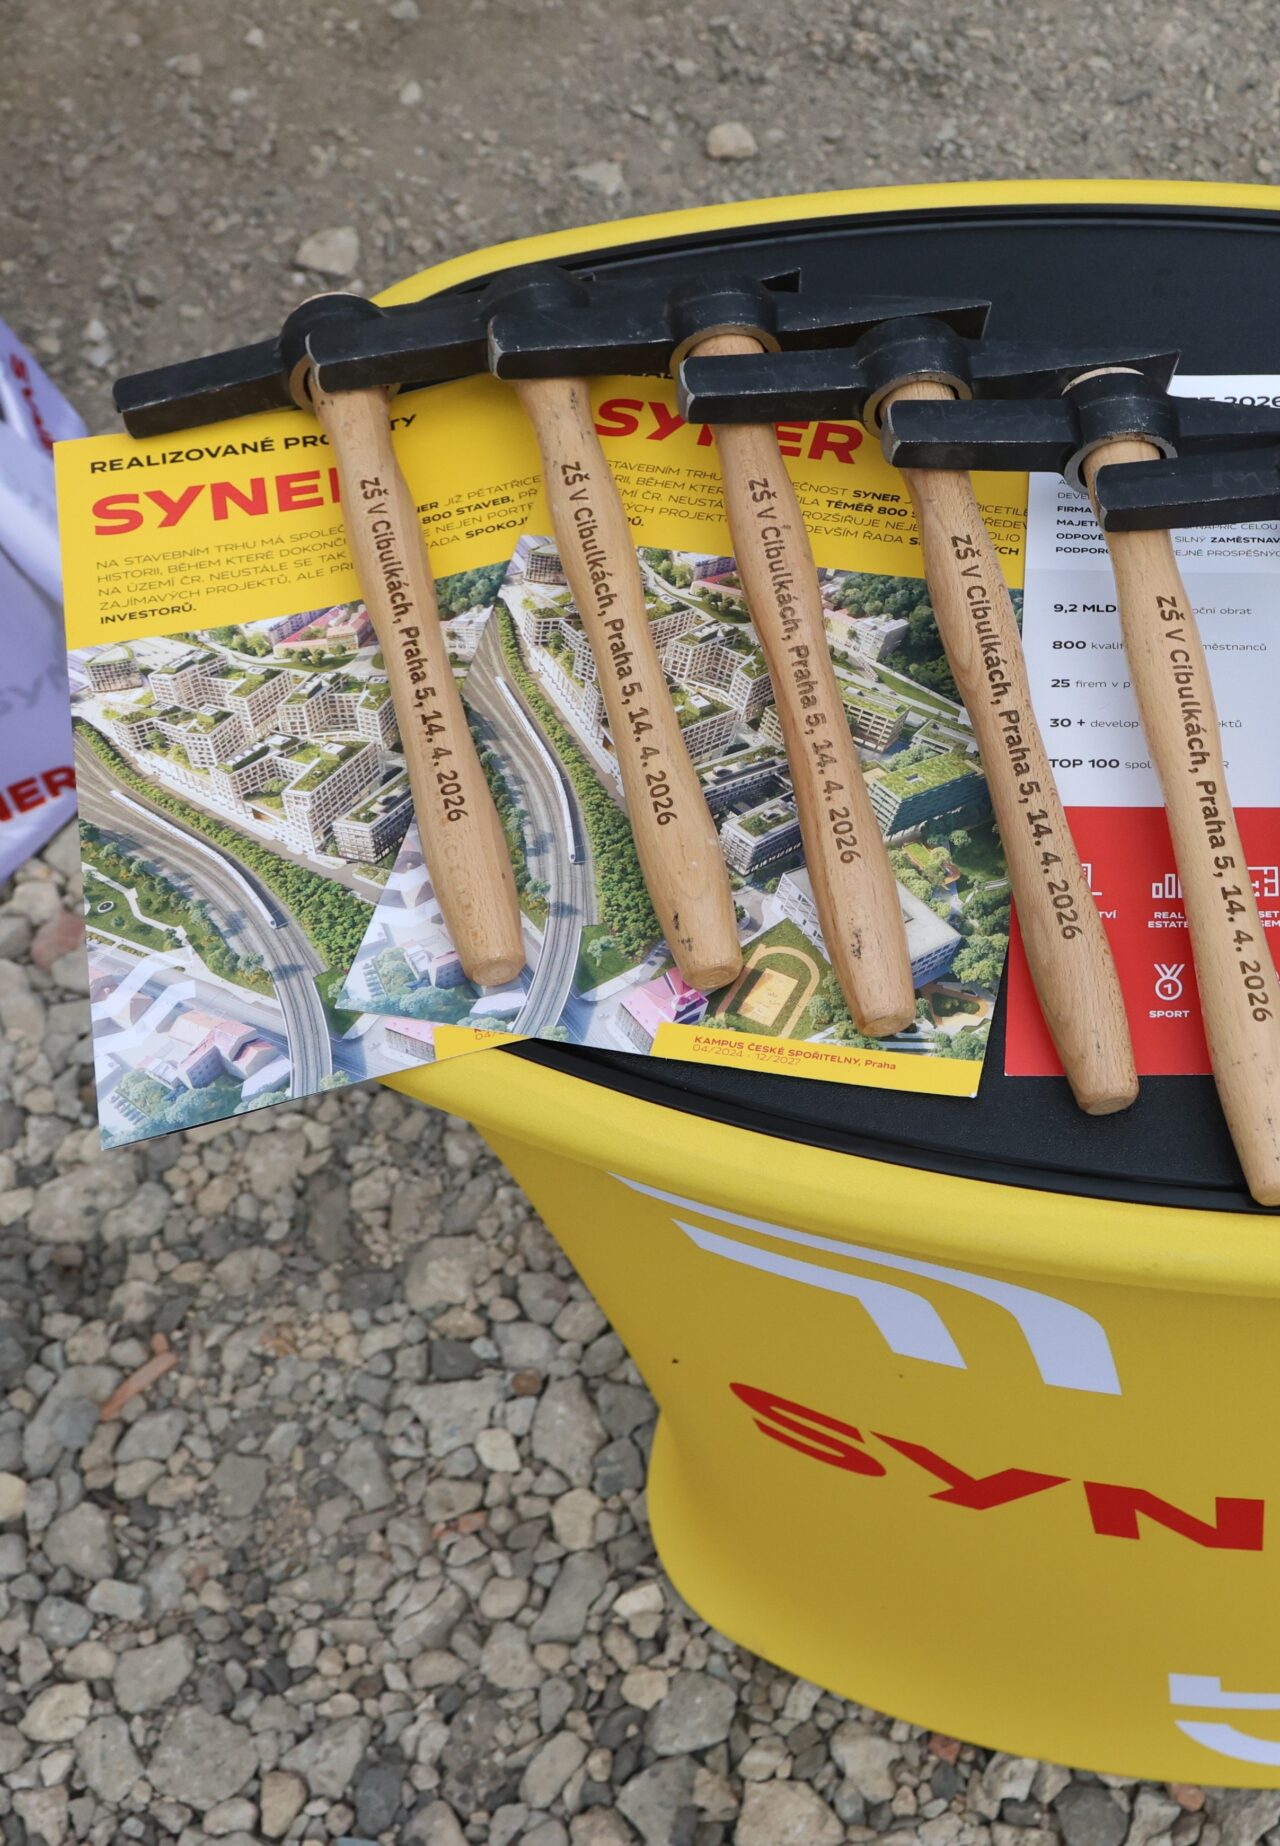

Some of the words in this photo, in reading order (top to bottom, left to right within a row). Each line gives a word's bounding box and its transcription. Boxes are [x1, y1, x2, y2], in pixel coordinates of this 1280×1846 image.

[594, 399, 864, 464] SYER
[91, 437, 275, 474] REALIZOVANÉ
[561, 461, 589, 487] ZŠ
[92, 467, 341, 535] SYNE
[361, 477, 389, 501] ZŠ
[569, 488, 588, 502] V
[636, 476, 685, 490] BĚHEM
[826, 500, 874, 513] TÉMĚŘ
[877, 507, 908, 516] 800
[748, 478, 776, 503] ZŠ
[852, 490, 900, 503] SYNER
[366, 502, 387, 515] V
[757, 507, 775, 520] V
[802, 511, 880, 528] ROZŠIŘUJE
[168, 558, 221, 575] BĚHEM
[226, 551, 273, 566] KTERÉ
[422, 511, 452, 524] 800
[456, 496, 514, 515] STAVEB,
[863, 531, 903, 543] ŘADA
[951, 534, 982, 561] ZŠ
[96, 560, 119, 570] NA
[124, 546, 209, 566] STAVEBNÍM
[214, 540, 256, 554] TRHU
[261, 535, 284, 548] MÁ
[98, 587, 121, 597] NA
[127, 576, 175, 594] ÚZEMÍ
[210, 561, 289, 581] NEUSTÁLE
[294, 558, 312, 568] SE
[318, 552, 346, 563] TAK
[436, 516, 482, 534] NEJEN
[574, 507, 617, 617] Cibulkách,
[372, 520, 412, 624] Cibulkách,
[961, 564, 980, 576] V
[99, 589, 201, 611] ZAJÍMAVÝCH
[206, 574, 292, 595] PROJEKTŮ,
[297, 567, 325, 581] ALE
[761, 527, 798, 641] Cibulkách,
[101, 603, 197, 624] INVESTORŮ.
[1054, 604, 1077, 613] 9,2
[1083, 604, 1116, 612] MLD
[1156, 595, 1186, 622] ZŠ
[966, 585, 1012, 705] Cibulkách,
[1052, 641, 1086, 649] 800
[1165, 627, 1185, 642] V
[399, 626, 427, 684] Praha
[605, 618, 633, 680] Praha
[788, 645, 816, 708] Praha
[1051, 679, 1070, 688] 25
[1075, 680, 1107, 688] firem
[414, 688, 436, 708] 5,
[622, 682, 642, 705] 5,
[628, 706, 653, 742] 14.
[1049, 719, 1071, 728] 30
[1170, 648, 1208, 773] Cibulkách,
[421, 711, 445, 742] 14.
[804, 714, 827, 735] 5,
[641, 745, 660, 767] 4.
[1000, 709, 1031, 777] Praha
[430, 747, 452, 768] 4.
[811, 739, 837, 775] 14.
[1049, 759, 1083, 768] TOP
[1088, 759, 1119, 768] 100
[436, 770, 469, 823] 2026
[646, 770, 678, 826] 2026
[823, 778, 844, 801] 4.
[1019, 781, 1041, 804] 5,
[1027, 808, 1053, 846] 14.
[1196, 781, 1225, 850] Praha
[828, 805, 861, 864] 2026
[1040, 849, 1061, 874] 4.
[1213, 856, 1235, 878] 5,
[1048, 879, 1082, 940] 2026
[1221, 884, 1247, 922] 14.
[1148, 920, 1189, 928] ESTATE
[1232, 928, 1254, 953] 4.
[1239, 958, 1273, 1023] 2026
[1149, 1010, 1189, 1018] SPORT
[692, 1044, 743, 1057] 04/2024
[756, 1053, 801, 1065] 12/2027
[694, 1036, 744, 1050] KAMPUS
[747, 1042, 785, 1055] ČESKÉ
[788, 1049, 860, 1066] SPOŘITELNY,
[865, 1059, 896, 1070] Praha
